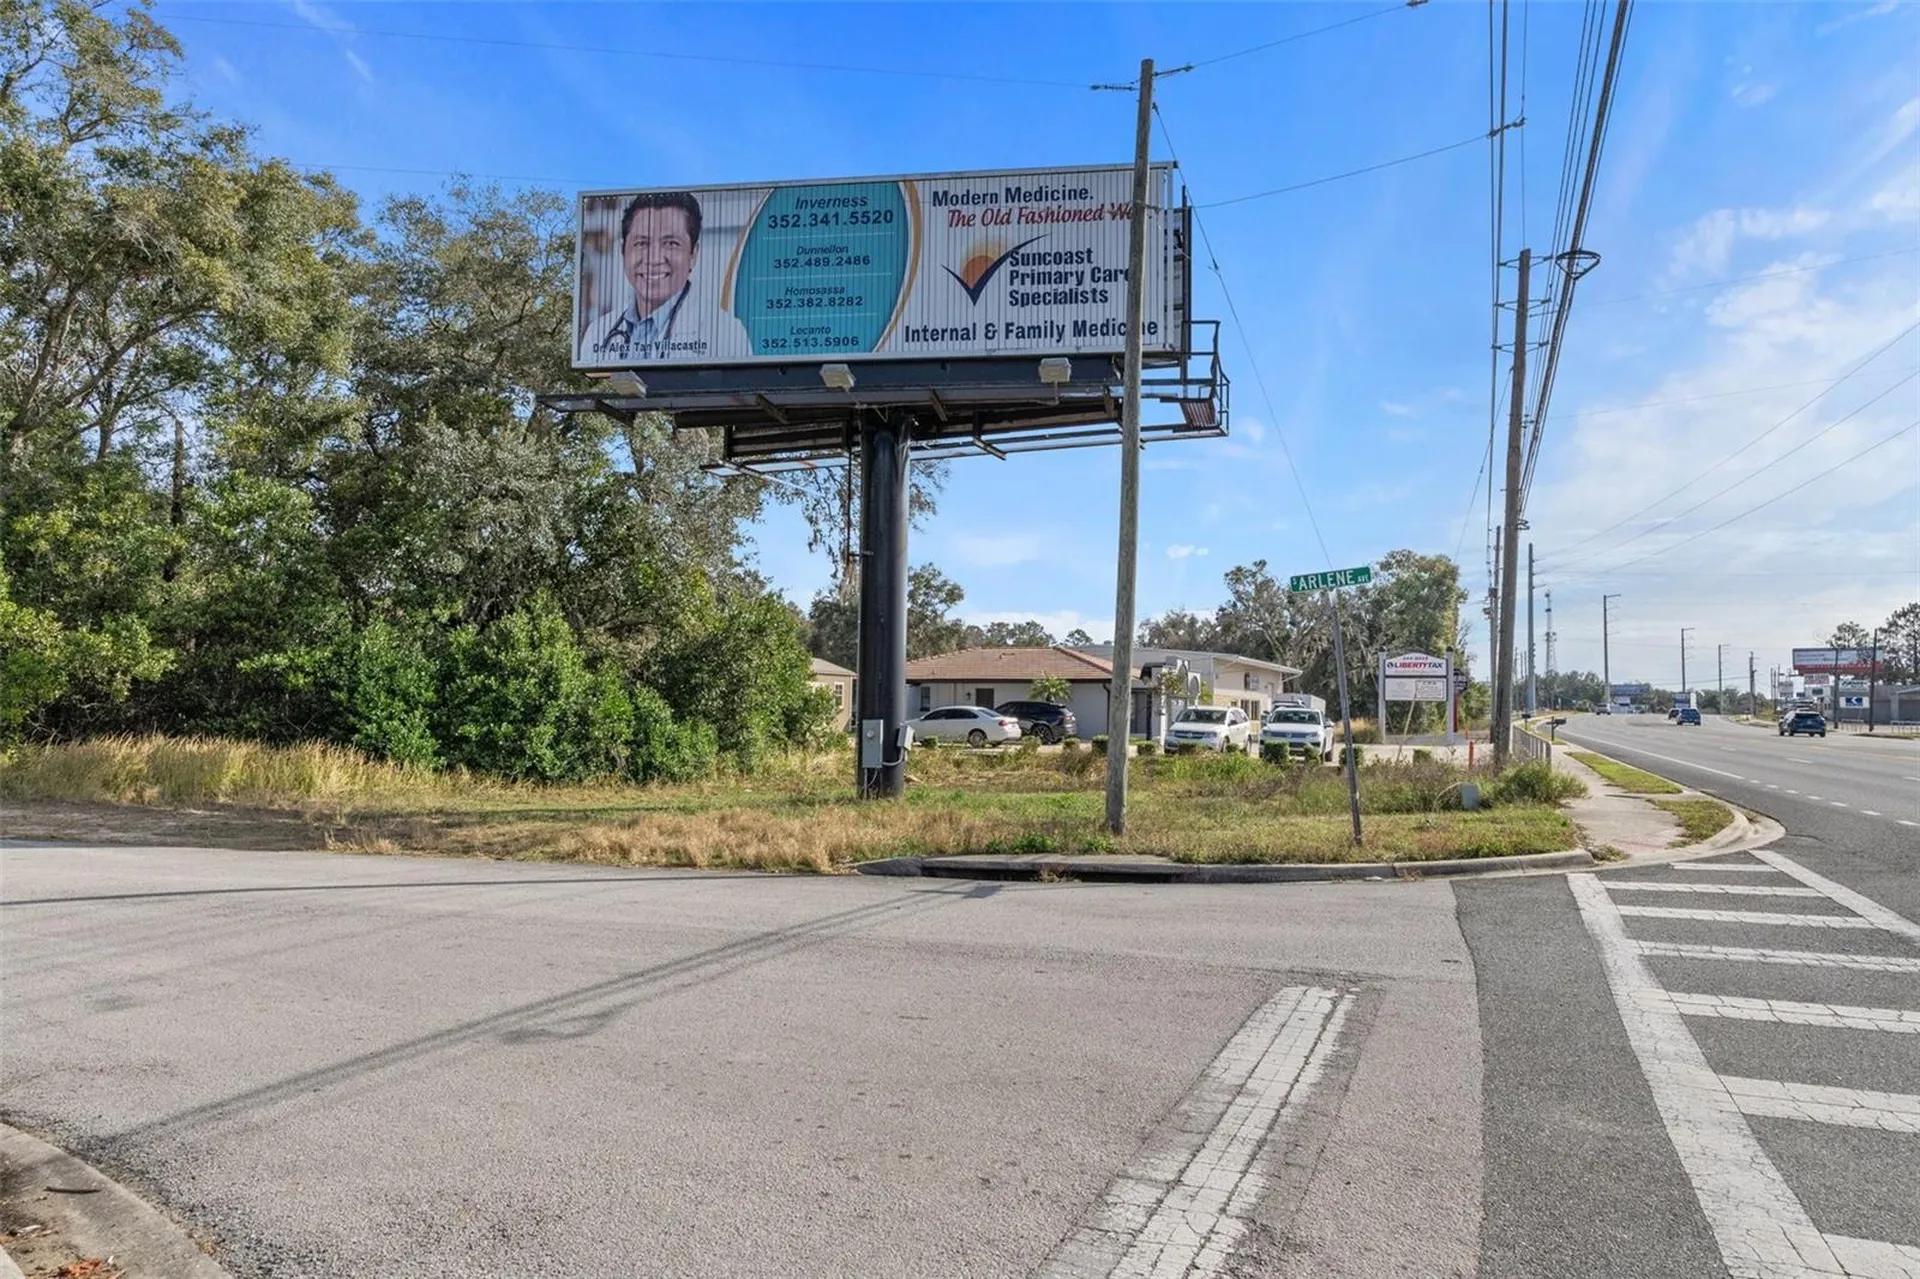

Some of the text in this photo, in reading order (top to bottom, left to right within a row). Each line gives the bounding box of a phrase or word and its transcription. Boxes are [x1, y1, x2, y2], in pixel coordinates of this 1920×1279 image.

[795, 196, 868, 210] Inverness
[932, 185, 1094, 207] Modern Medicine.
[768, 209, 894, 229] 352.341.5520
[948, 208, 976, 228] The
[981, 207, 1012, 226] Old
[1017, 203, 1105, 225] Fashioned
[796, 244, 849, 255] Dunnellon
[1009, 248, 1094, 267] Suncoast
[773, 255, 871, 269] 352.489.2486
[1009, 268, 1085, 287] Primary
[785, 286, 846, 296] Homosassa
[1009, 287, 1109, 308] Specialists
[766, 296, 864, 309] 352.382.8282
[790, 326, 832, 335] Lecanto
[904, 318, 1158, 343] Internal & Family Medice
[609, 342, 631, 352] Alex
[634, 342, 652, 351] Tan
[654, 340, 708, 351] Villacastin
[761, 336, 860, 349] 352.513.5906
[1299, 570, 1355, 590] ARLENE
